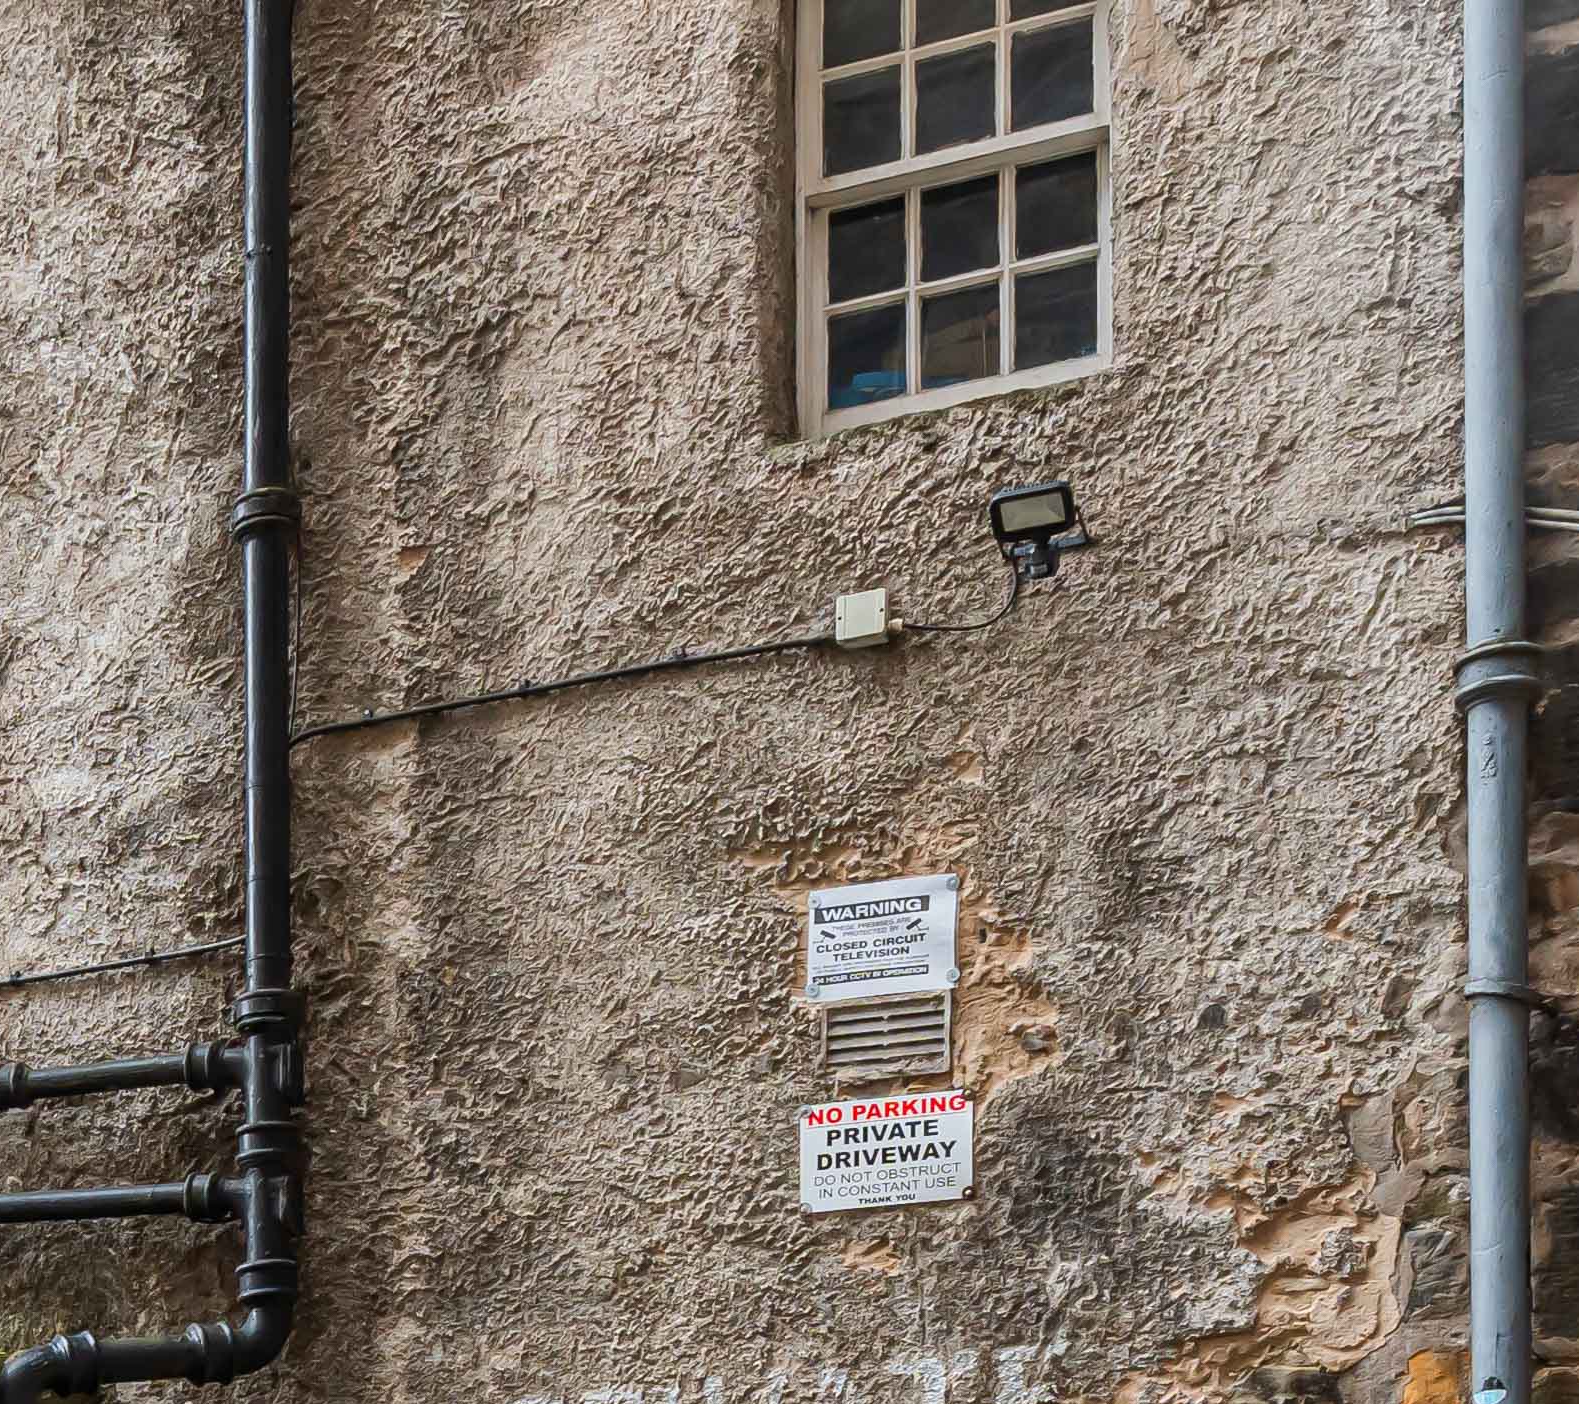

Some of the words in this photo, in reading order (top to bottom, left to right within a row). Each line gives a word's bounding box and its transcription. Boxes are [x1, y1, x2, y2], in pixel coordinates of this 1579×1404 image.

[822, 899, 921, 921] WARNING
[816, 940, 867, 953] CLOSED
[873, 933, 926, 947] CIRCUIT
[833, 946, 910, 962] TELEVISION
[826, 974, 848, 983] HOUR
[850, 972, 872, 980] CCTV
[809, 1108, 842, 1126] NO
[853, 1095, 966, 1120] PARKING
[827, 1119, 939, 1146] PRIVATE
[817, 1141, 957, 1171] DRIVEWAY
[814, 1175, 836, 1186] DO
[841, 1171, 872, 1184] NOT
[877, 1163, 961, 1180] OBSTRUCT
[819, 1188, 833, 1198] IN
[838, 1179, 920, 1197] CONSTANT
[925, 1176, 956, 1188] USE
[859, 1195, 891, 1205] THANK
